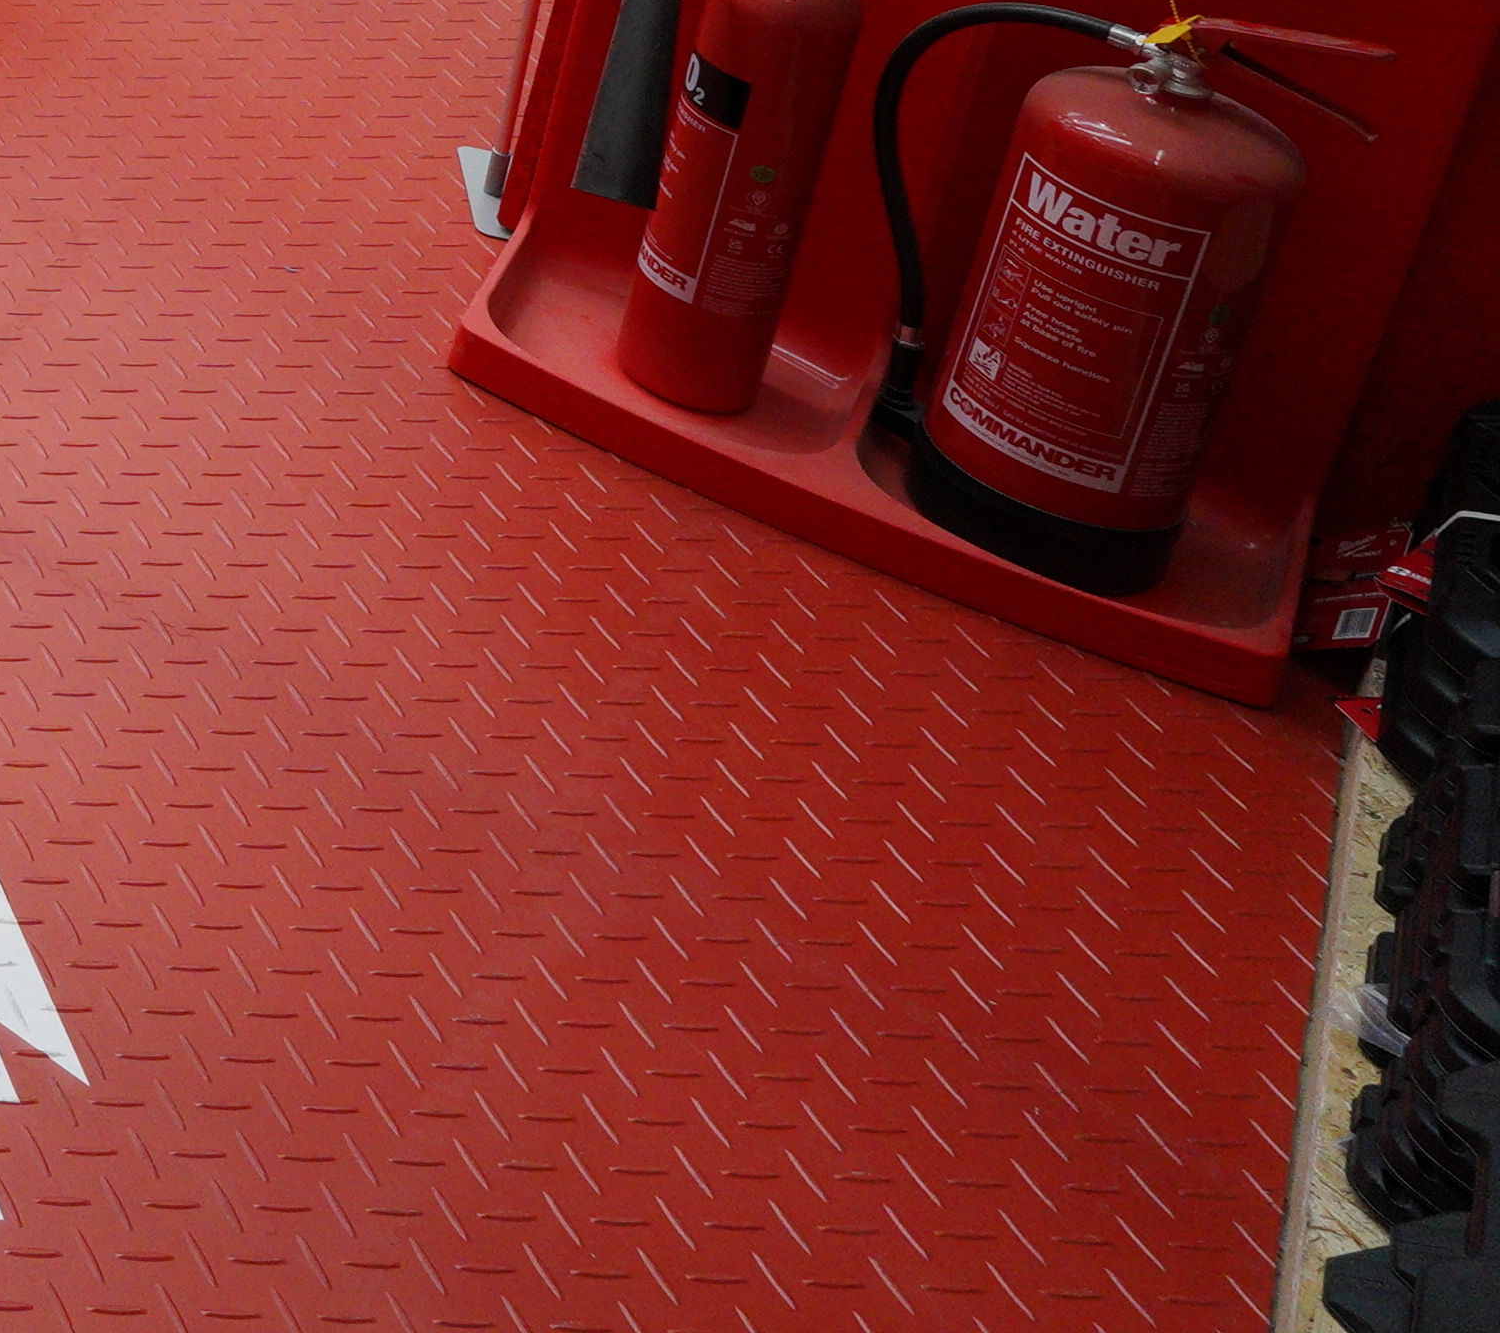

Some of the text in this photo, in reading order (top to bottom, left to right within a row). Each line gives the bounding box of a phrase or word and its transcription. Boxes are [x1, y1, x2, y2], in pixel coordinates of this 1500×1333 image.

[1015, 217, 1161, 292] FIRE EXTINGUISHER
[1027, 170, 1183, 268] Water
[1045, 252, 1083, 275] WATER
[950, 387, 1118, 481] COMMANDER
